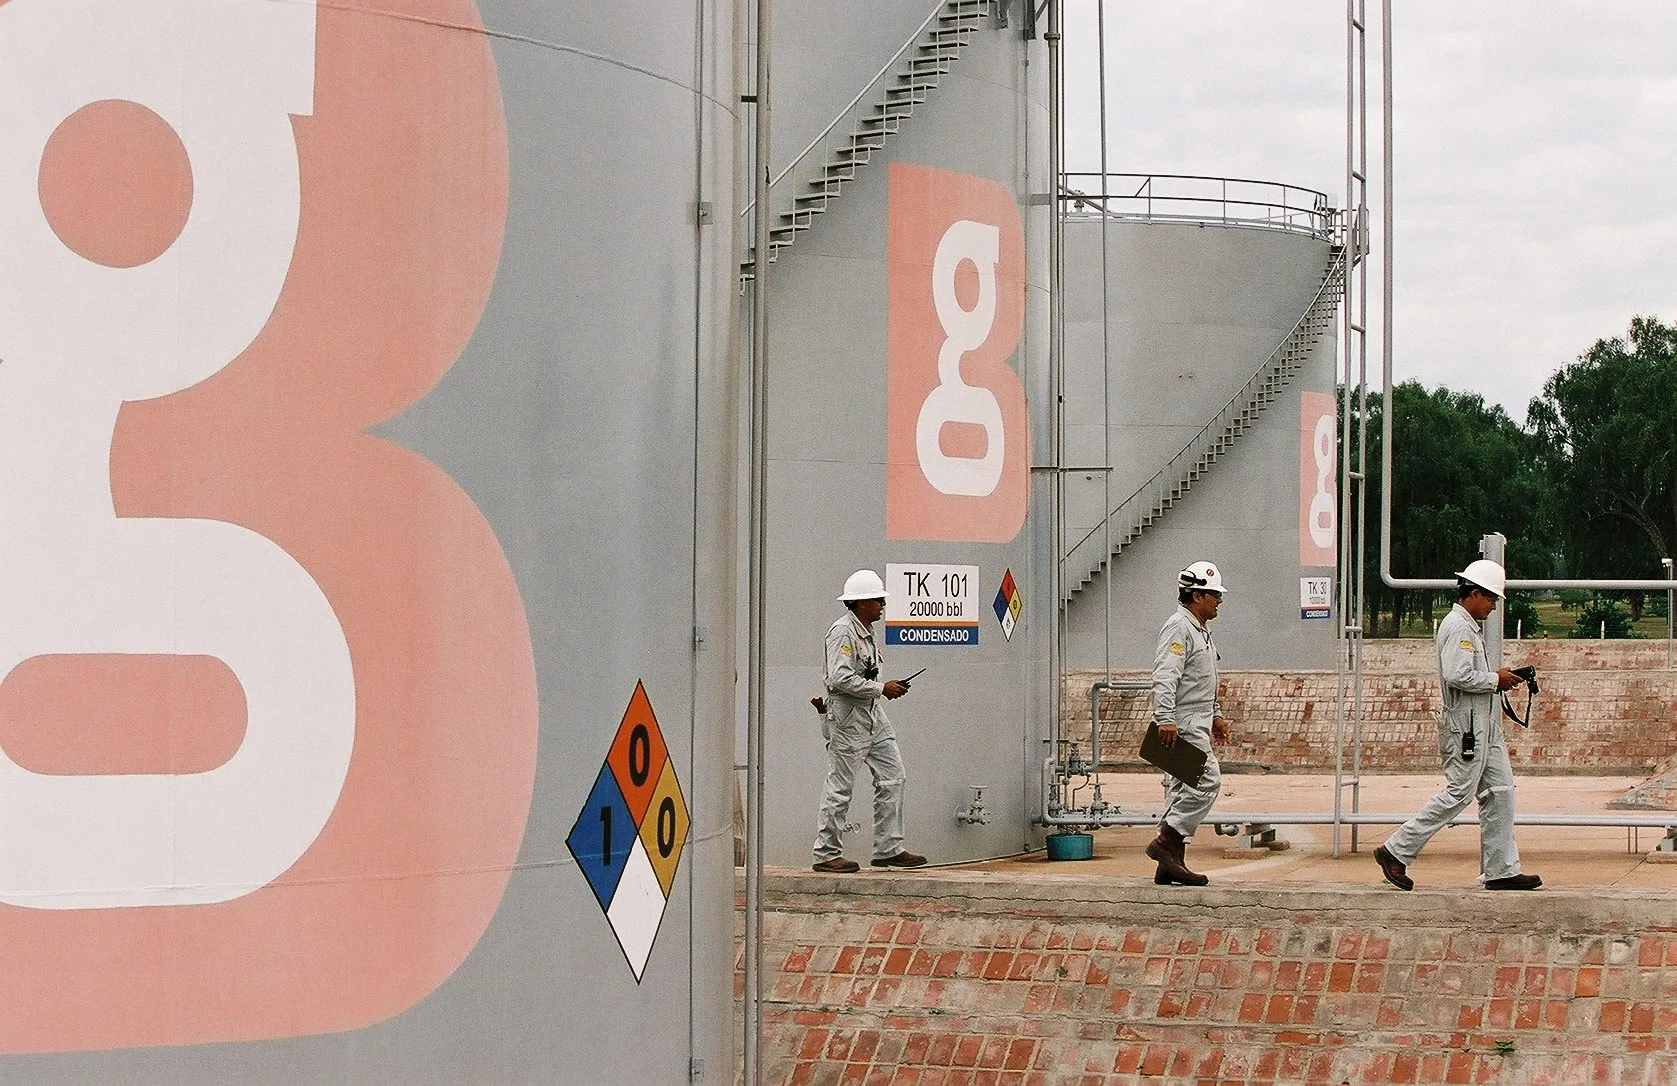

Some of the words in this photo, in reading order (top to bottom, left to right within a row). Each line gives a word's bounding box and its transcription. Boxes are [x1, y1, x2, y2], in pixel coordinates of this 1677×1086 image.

[903, 571, 931, 597] TK
[941, 573, 968, 598] 101
[1307, 581, 1318, 595] TK
[909, 601, 944, 617] 20000
[946, 601, 963, 617] bbl
[899, 628, 969, 642] CONDENSADO
[628, 723, 651, 788] 0
[599, 805, 613, 867] 1
[656, 796, 677, 859] 0
